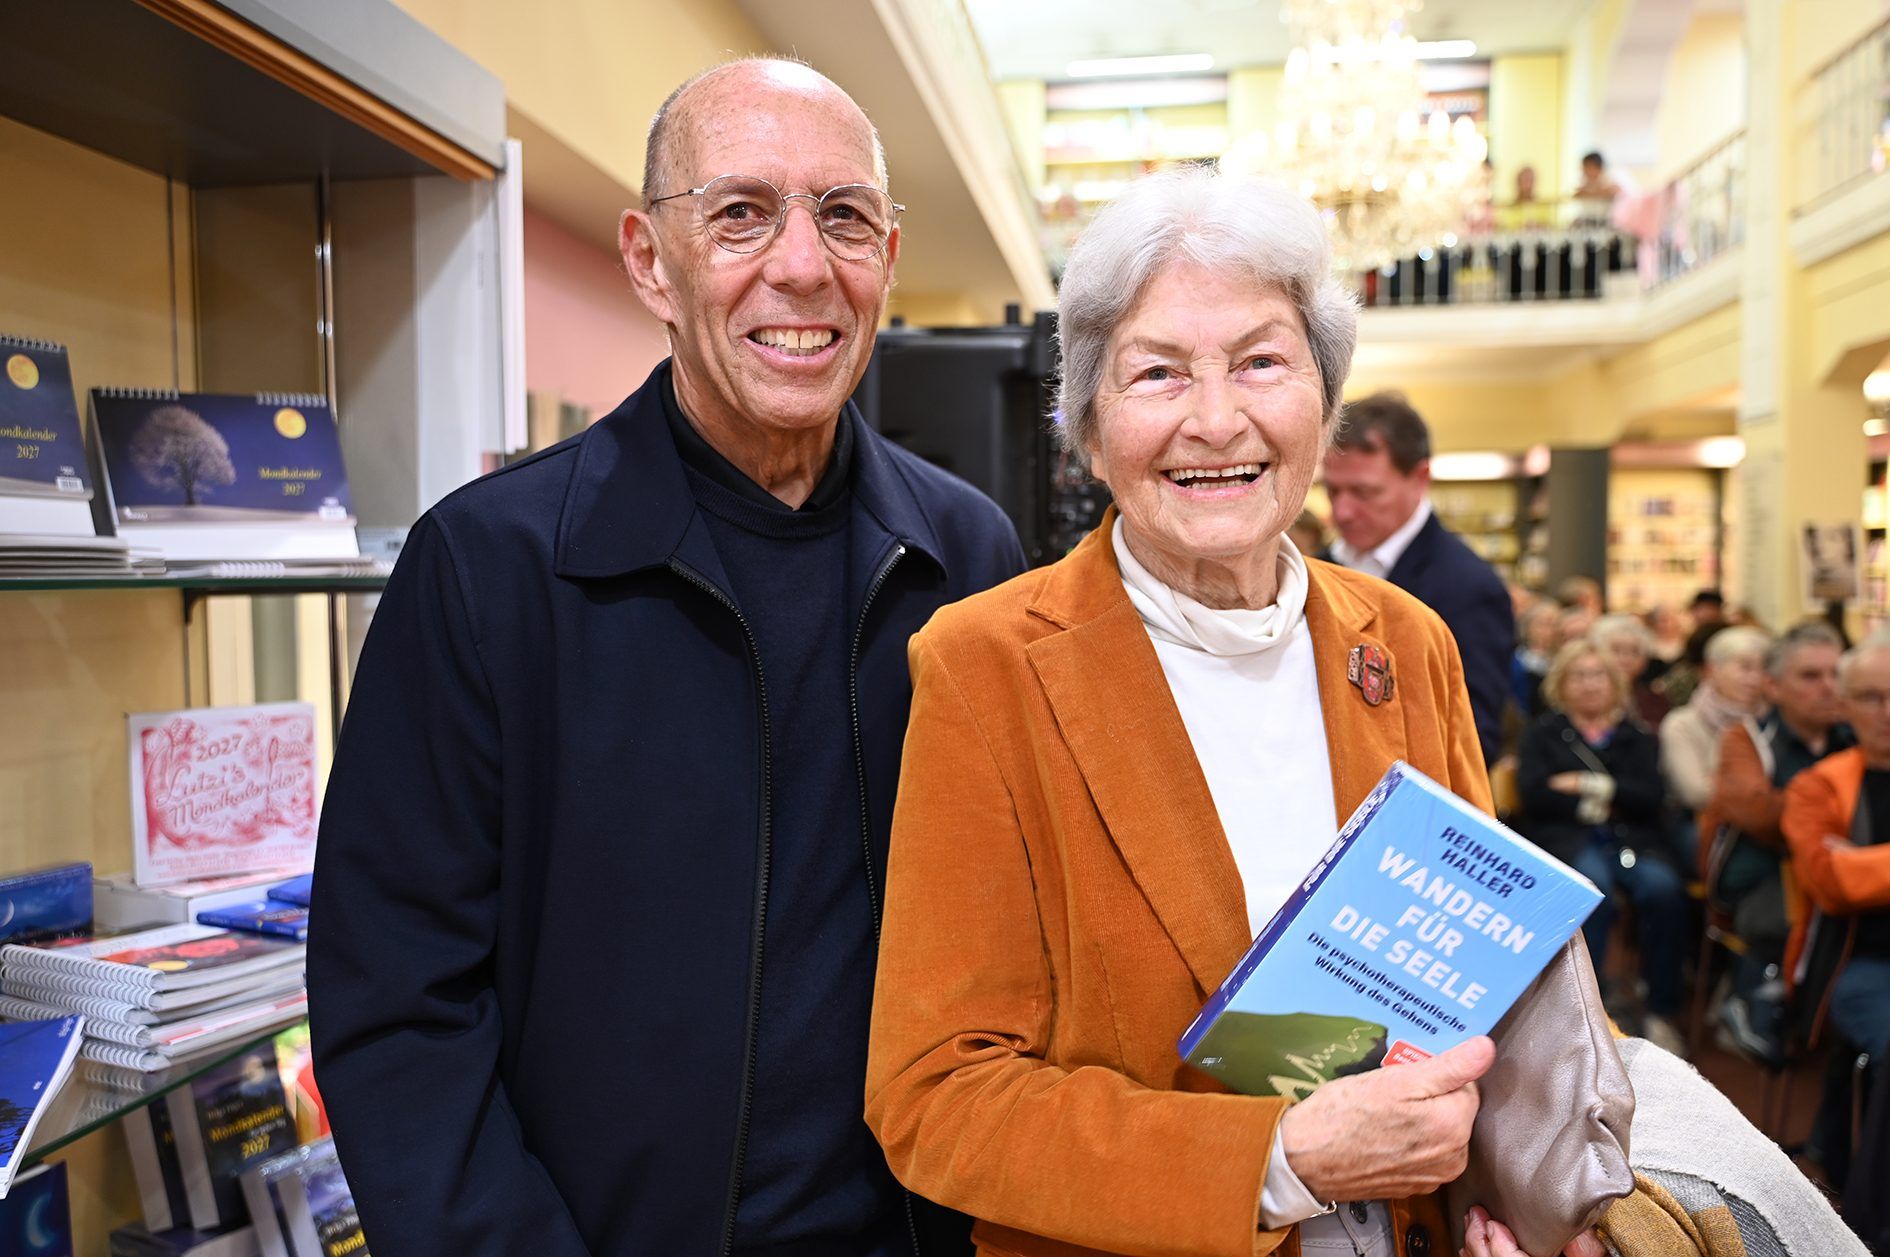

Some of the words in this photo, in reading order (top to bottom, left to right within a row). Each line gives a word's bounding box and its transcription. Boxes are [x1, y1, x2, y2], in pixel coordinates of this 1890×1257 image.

[0, 424, 58, 442] ondkalender
[17, 444, 40, 459] 2027
[259, 466, 323, 480] Mondkalender
[198, 734, 242, 761] 2027
[1440, 825, 1537, 890] REINHARD
[1440, 848, 1515, 898] HALLER
[1377, 845, 1535, 955] WANDERN
[1395, 904, 1465, 957] FÜR
[1329, 904, 1391, 951] DIE
[1384, 939, 1488, 1010] SEELE
[1306, 931, 1331, 951] Die
[1328, 947, 1468, 1033] psychotherapeutische
[1314, 954, 1367, 995] Wirkung
[1367, 988, 1392, 1007] des
[1391, 1001, 1440, 1036] Gehens
[208, 1104, 285, 1142] Mondkalender
[242, 1132, 271, 1159] 2027
[329, 1228, 366, 1257] Mond
